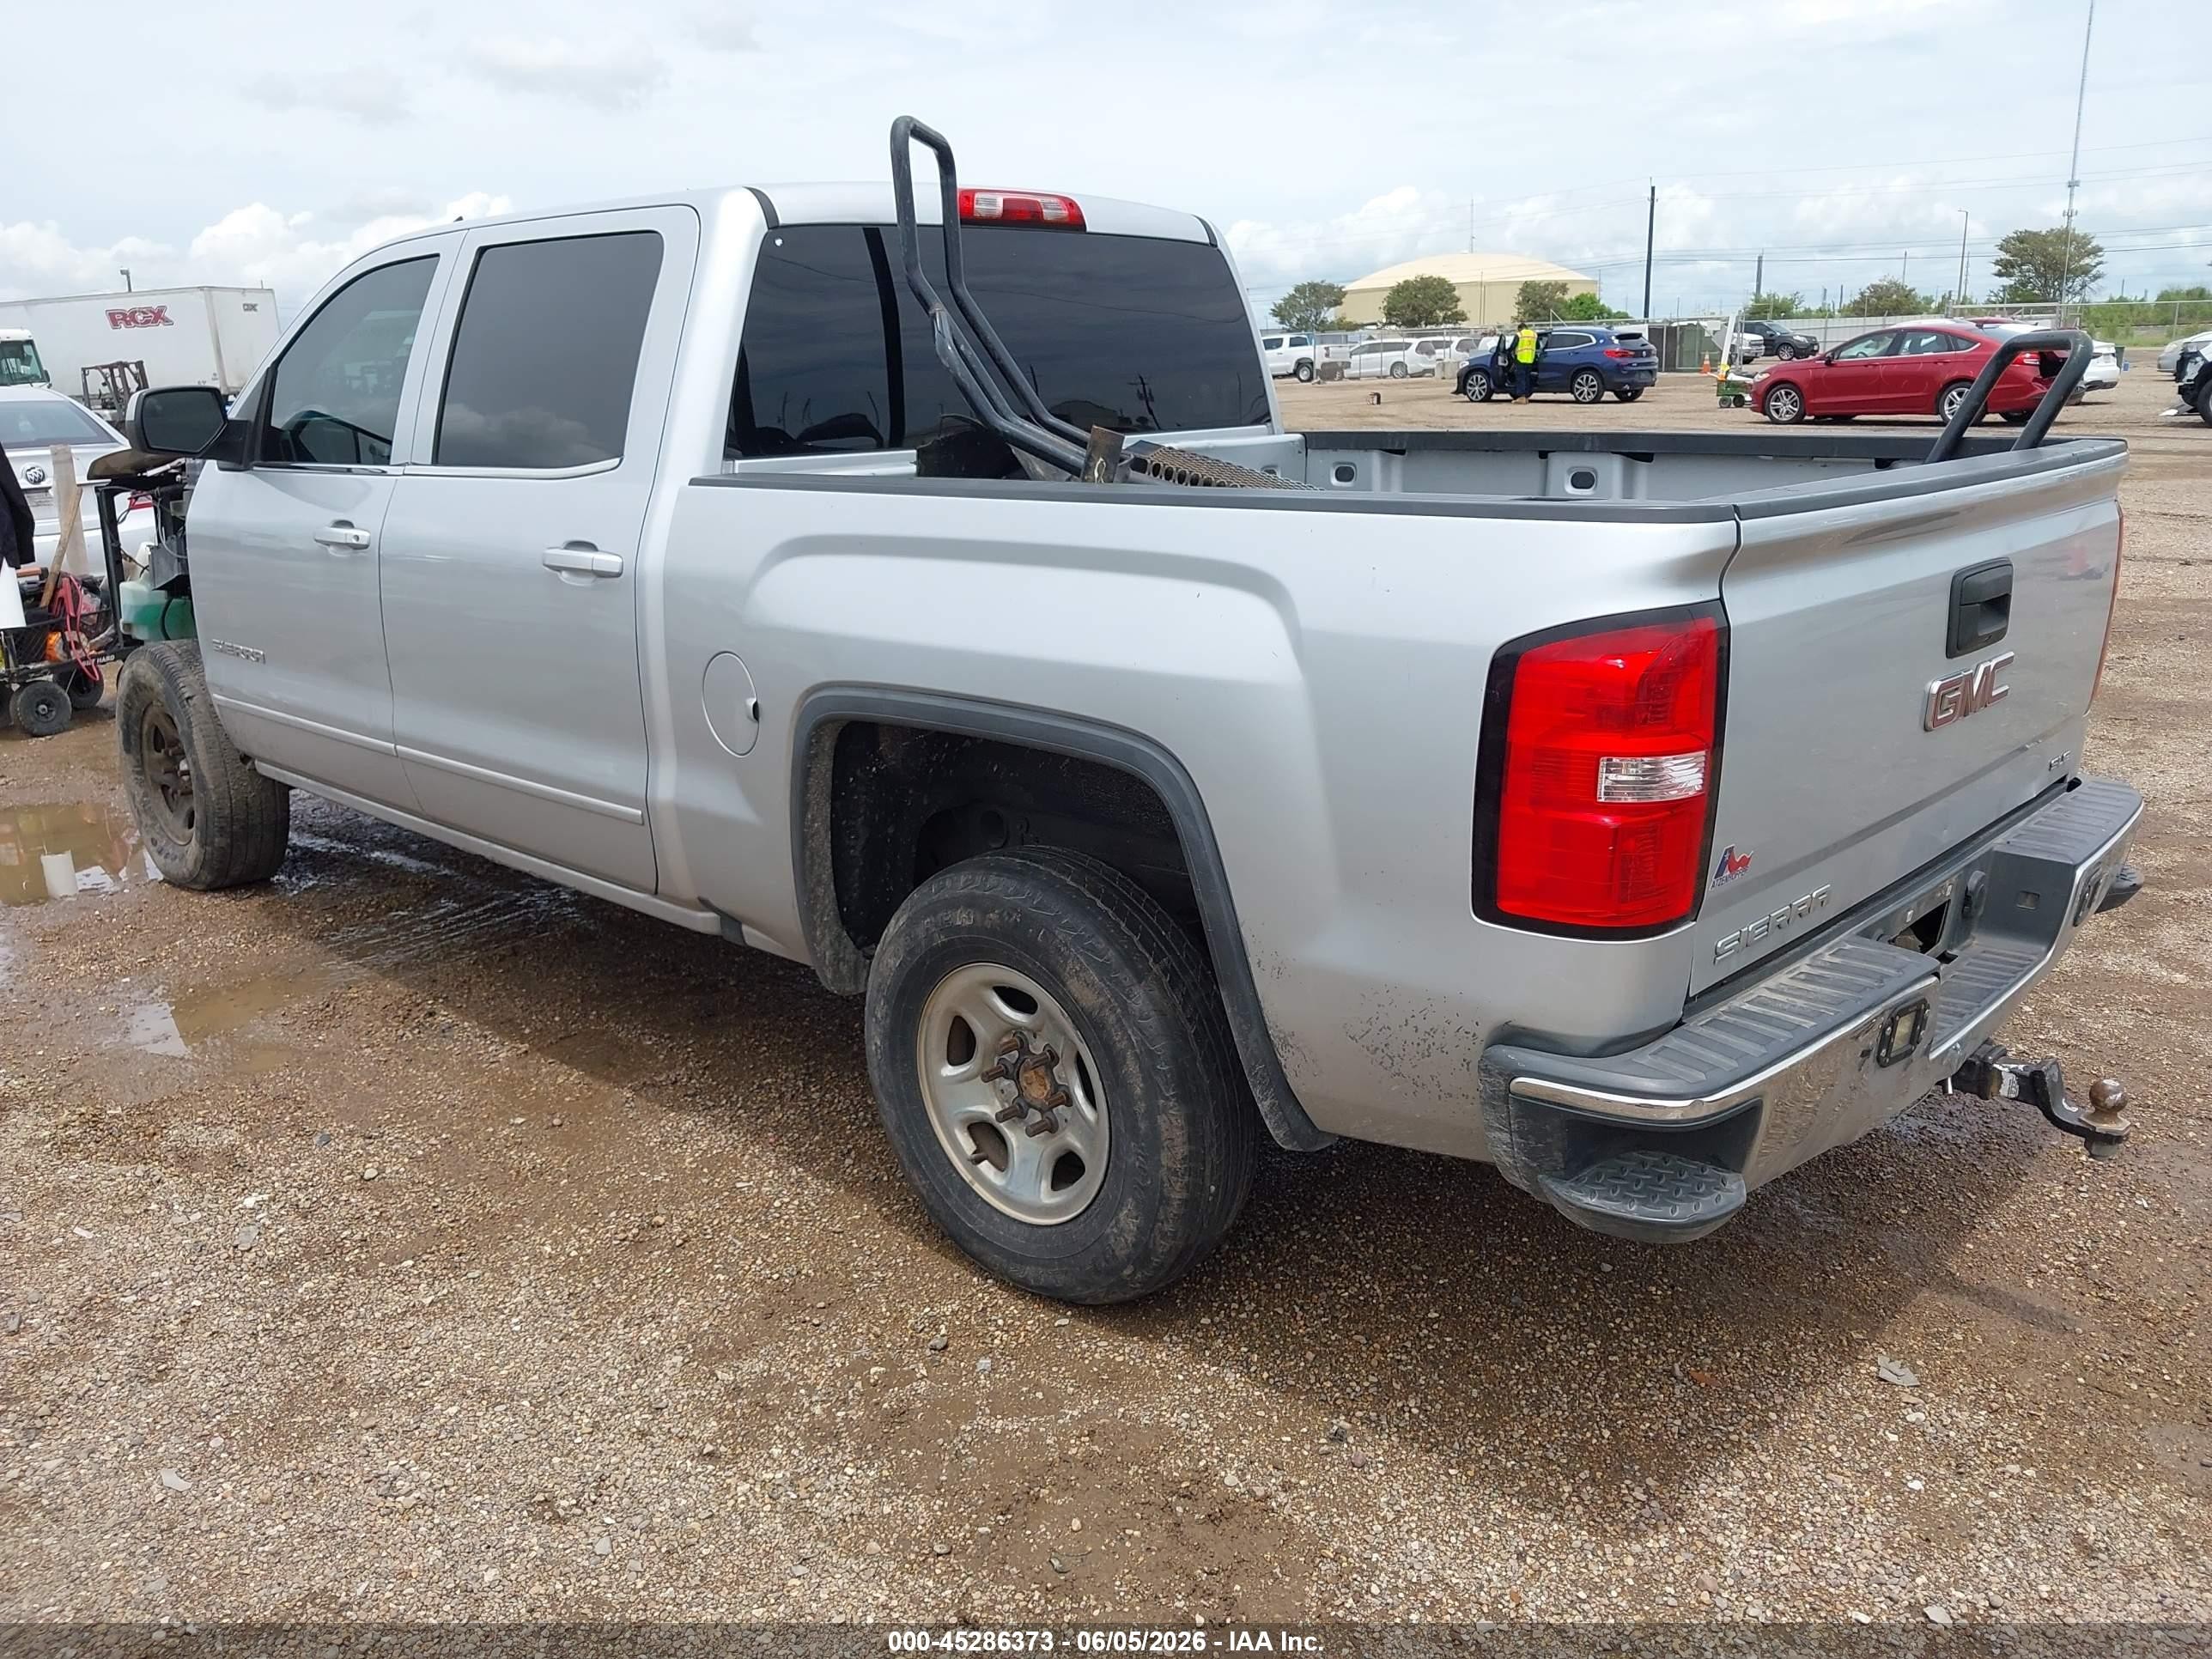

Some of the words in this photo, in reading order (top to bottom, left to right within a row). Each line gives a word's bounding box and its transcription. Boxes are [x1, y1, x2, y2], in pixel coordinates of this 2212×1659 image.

[105, 305, 174, 330] RCX
[1924, 651, 2014, 732] GMC
[1713, 884, 1831, 965] SIERRA
